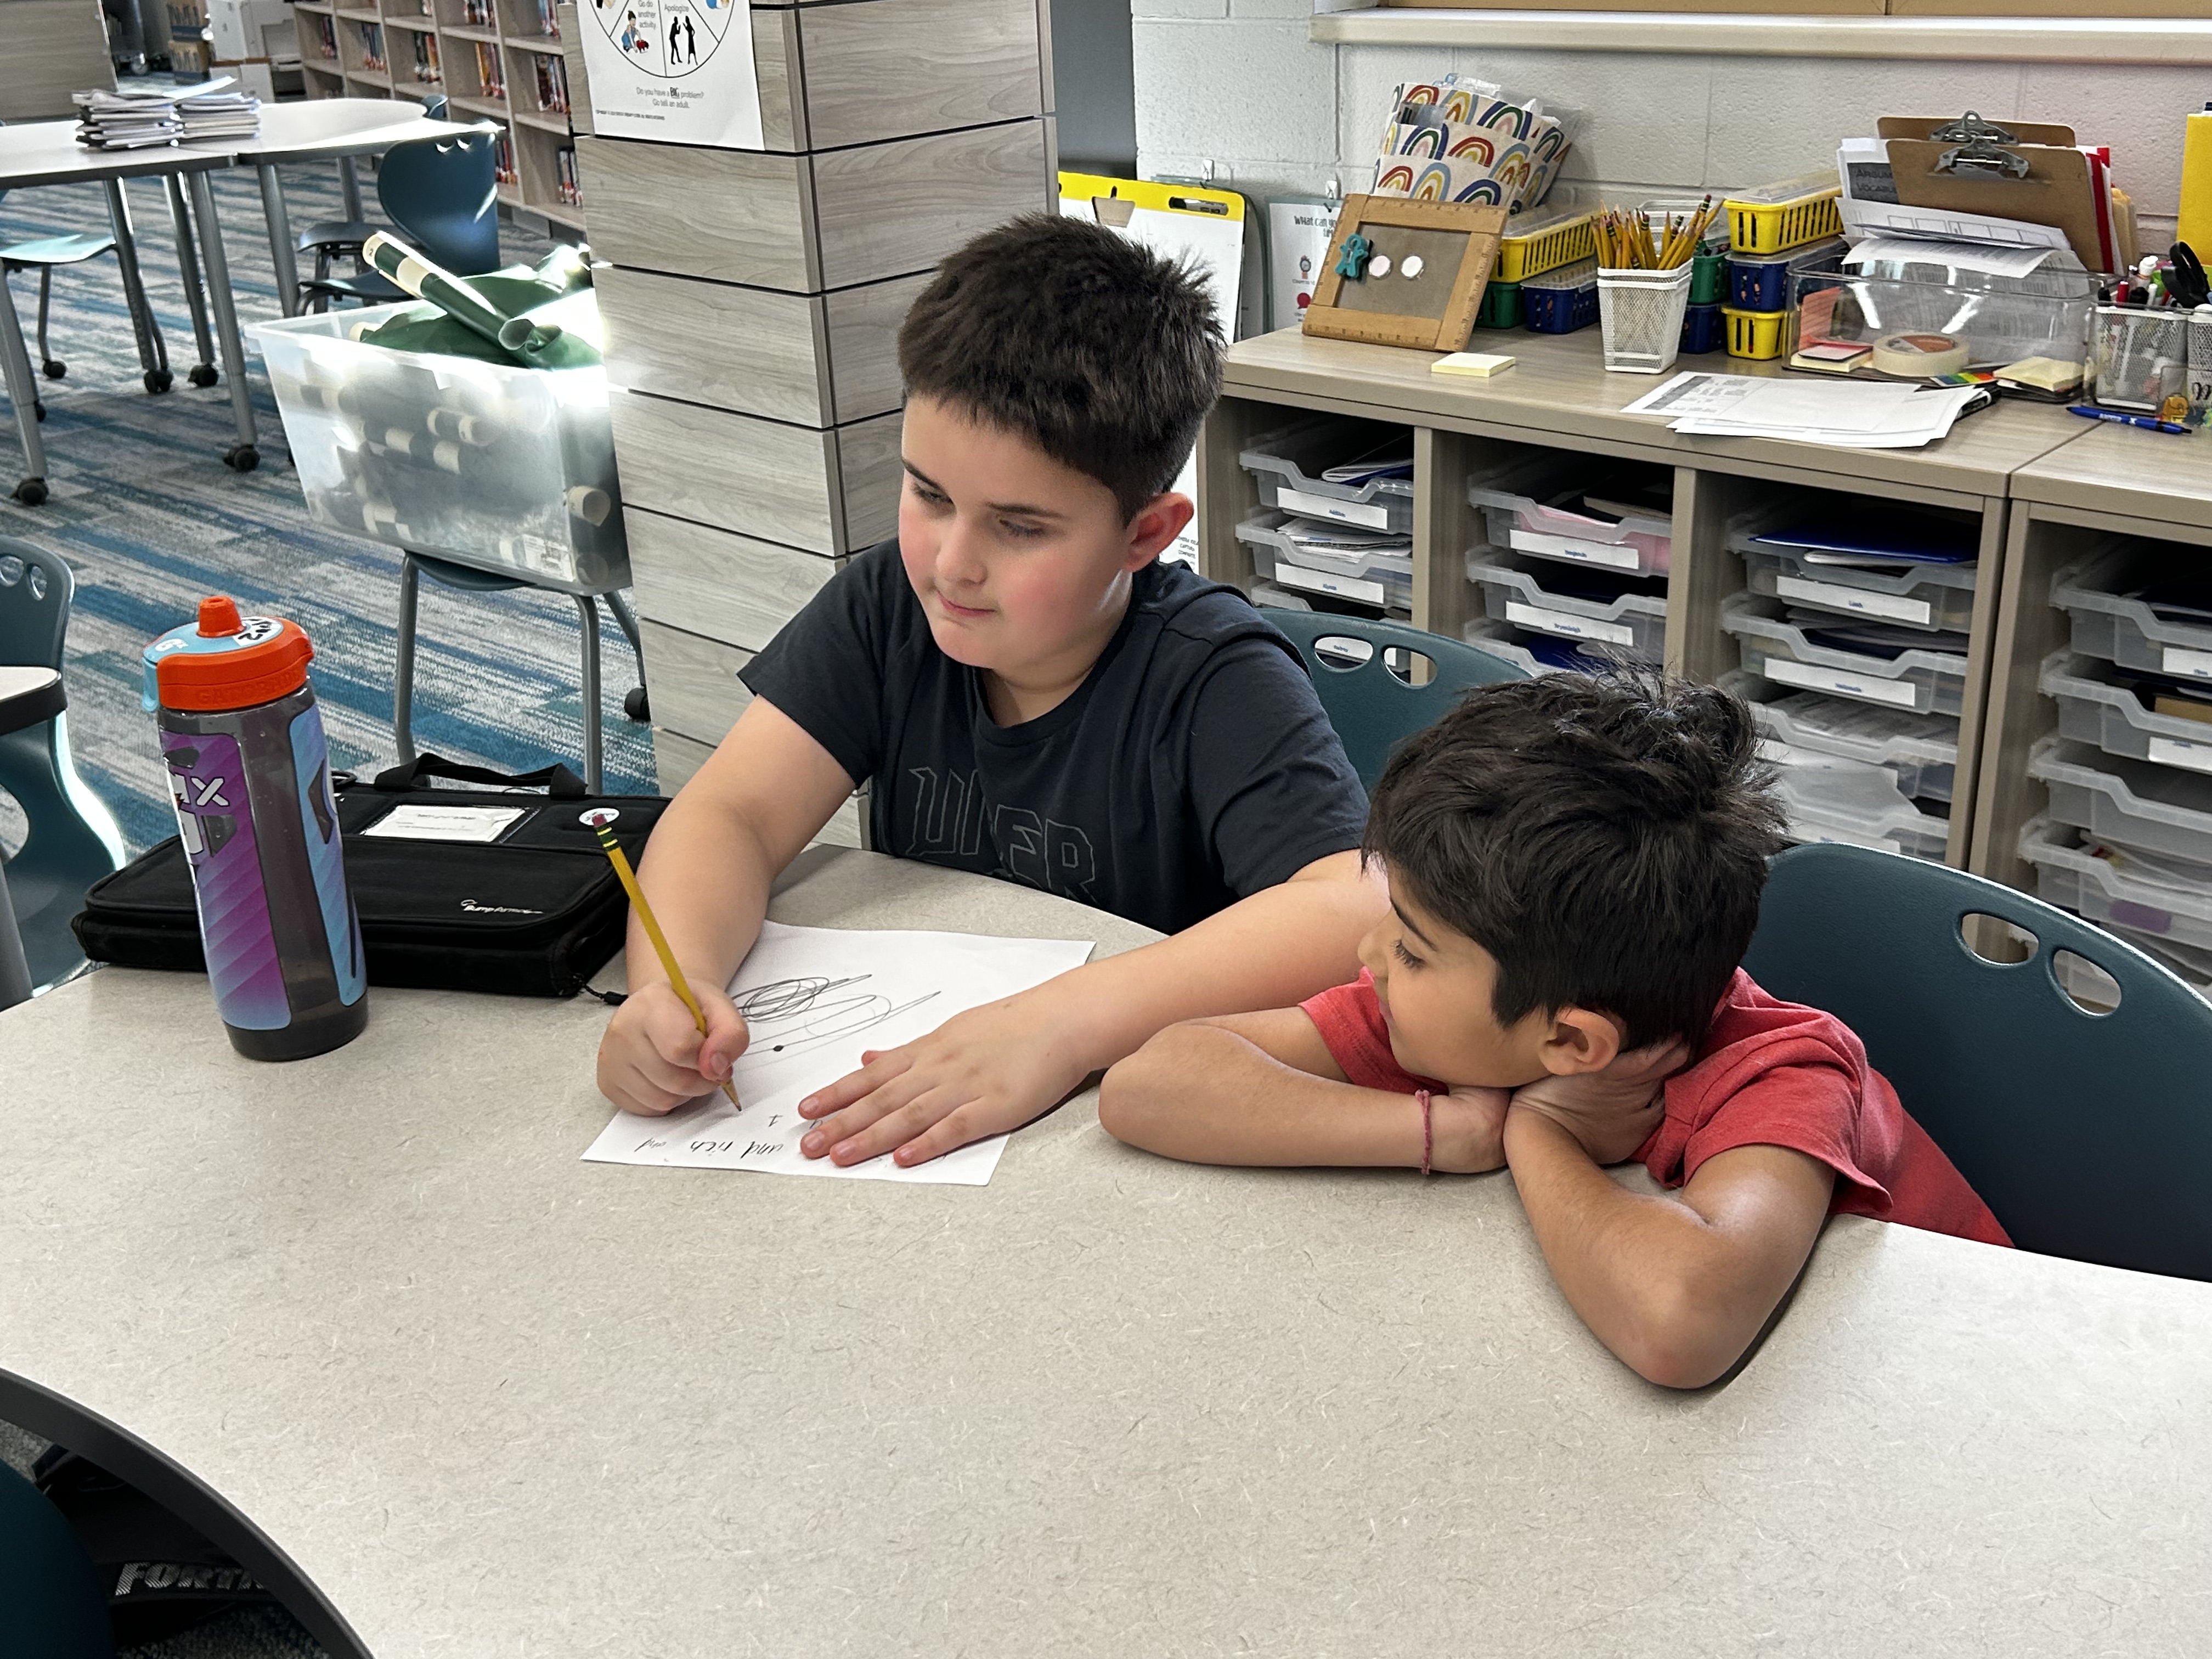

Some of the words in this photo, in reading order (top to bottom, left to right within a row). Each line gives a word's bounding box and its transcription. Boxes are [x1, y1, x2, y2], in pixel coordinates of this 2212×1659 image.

[664, 4, 689, 14] Apologize
[670, 87, 680, 99] BIG
[680, 91, 704, 99] problem?
[1314, 218, 1328, 227] can
[740, 1141, 784, 1159] and
